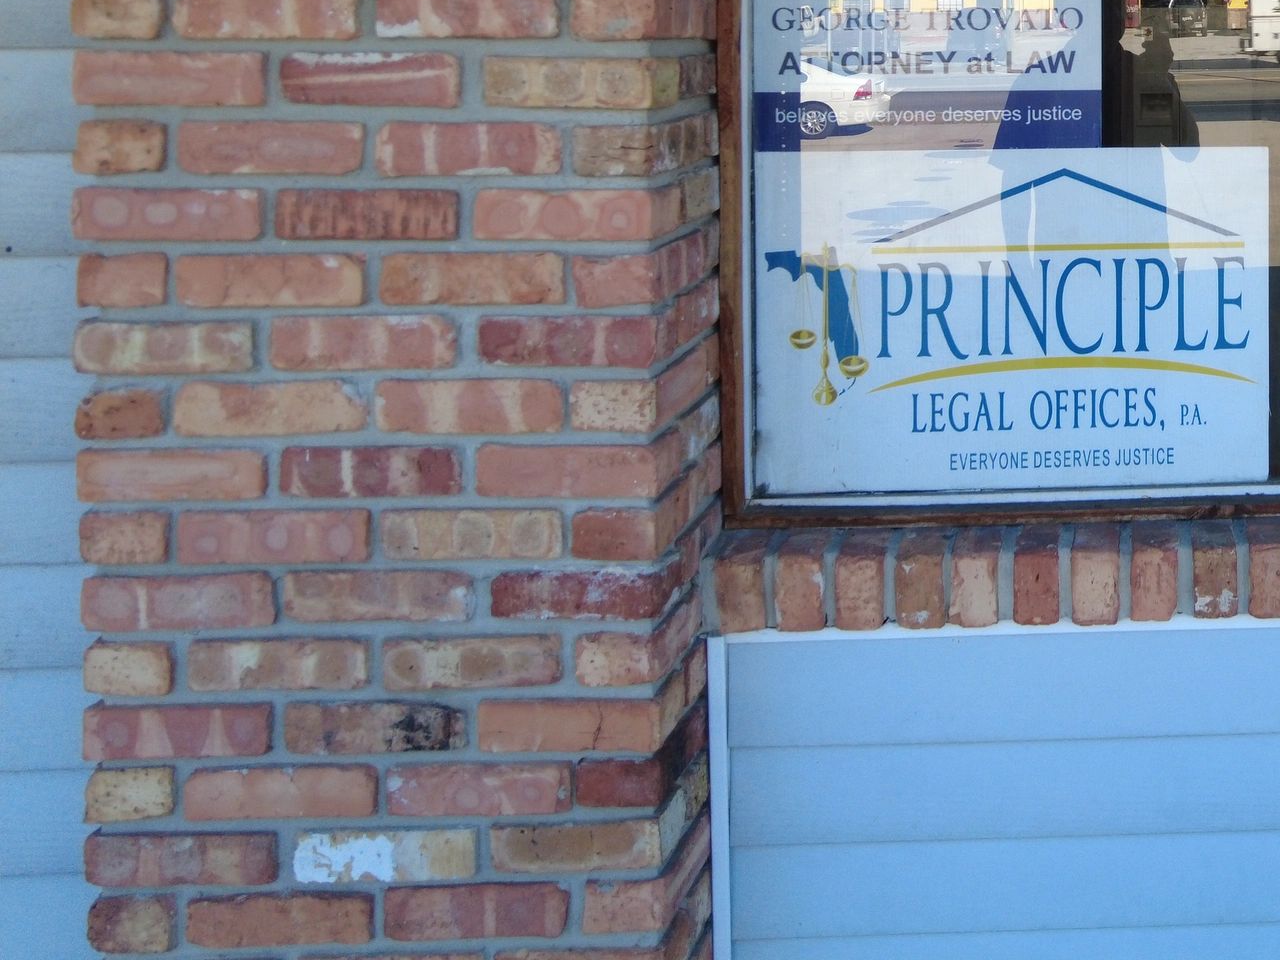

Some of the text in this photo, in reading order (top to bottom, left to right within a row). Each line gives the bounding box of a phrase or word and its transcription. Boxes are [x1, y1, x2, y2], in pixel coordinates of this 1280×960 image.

[772, 7, 1083, 32] GEORGE TROVATO
[778, 50, 1076, 76] ATTORNEY at LAW
[775, 106, 1082, 126] believes everyone deserves justice
[876, 256, 1251, 361] PRINCIPLE
[911, 387, 1208, 434] LEGAL OFFICES, P.A.
[949, 447, 1175, 471] EVERYONE DESERVES JUSTICE
